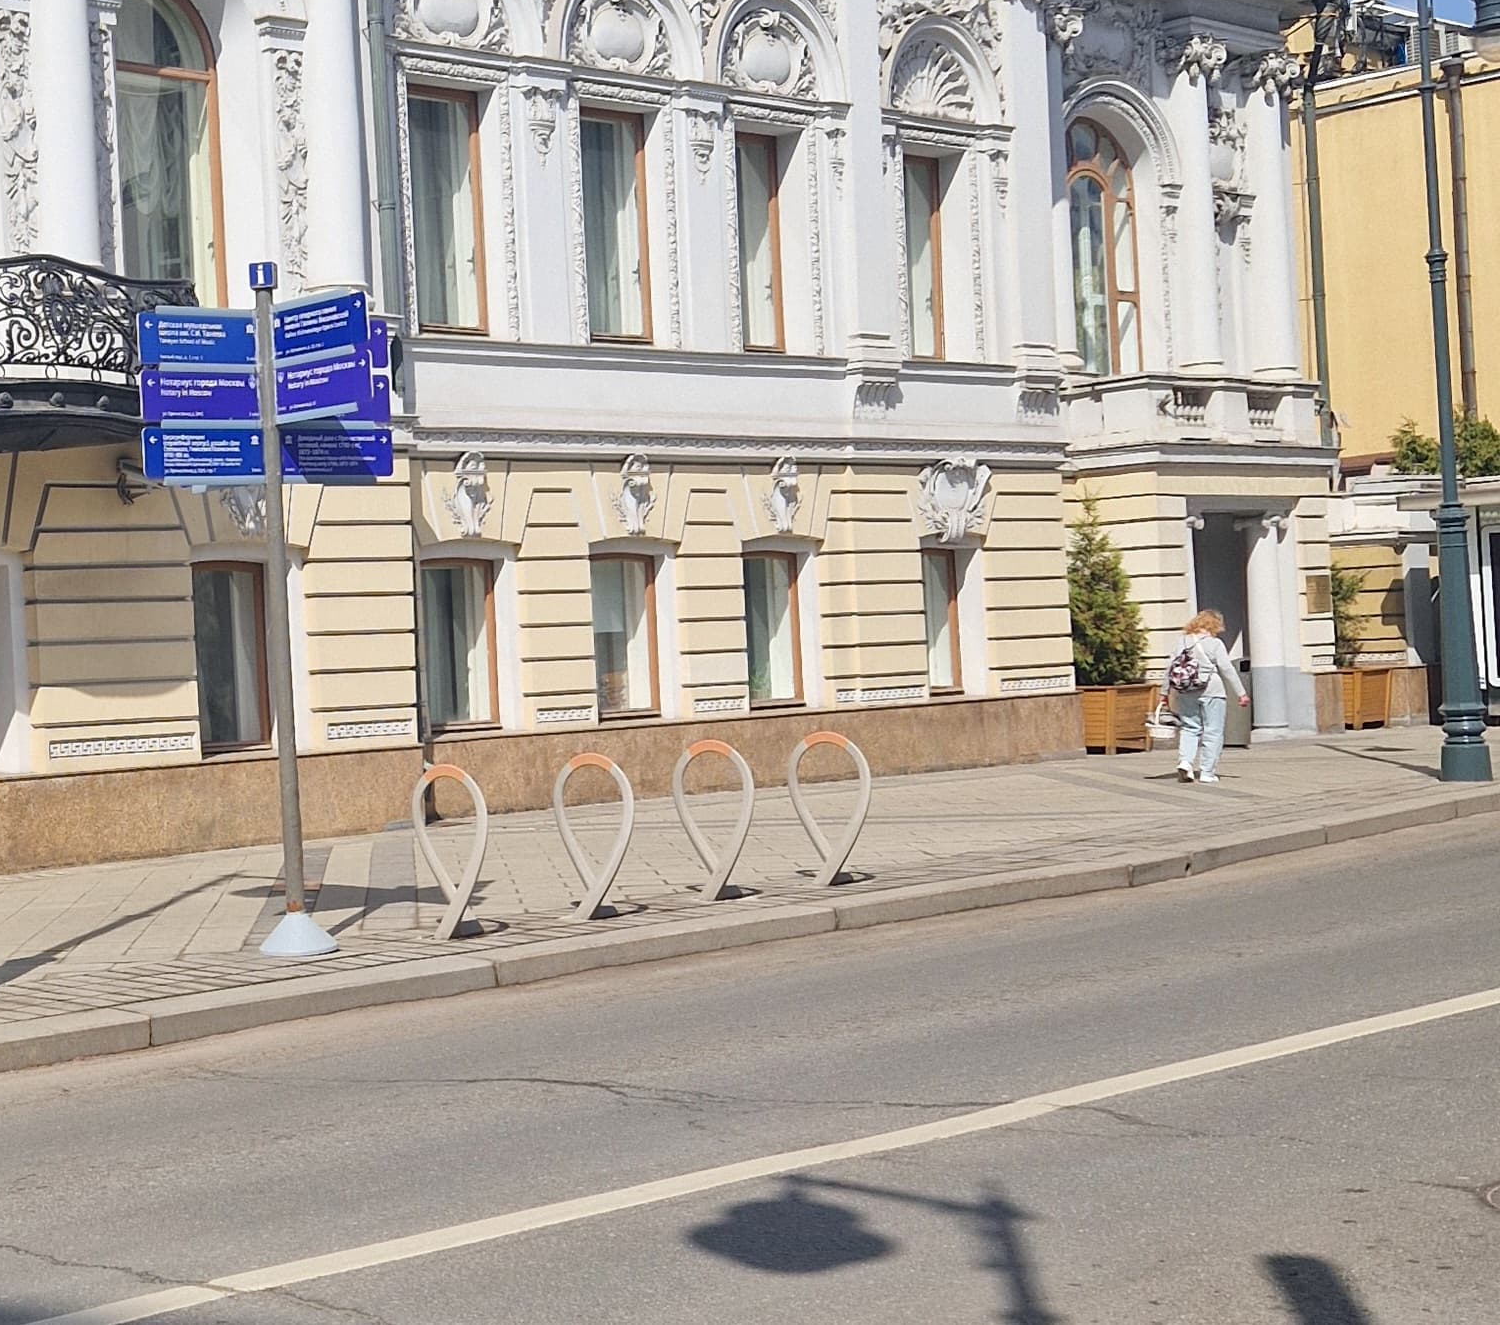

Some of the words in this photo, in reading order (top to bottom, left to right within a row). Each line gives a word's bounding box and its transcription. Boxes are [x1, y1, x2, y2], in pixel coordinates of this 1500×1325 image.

[160, 378, 192, 387] Нотариус
[193, 379, 217, 388] города
[218, 379, 245, 387] Москвы
